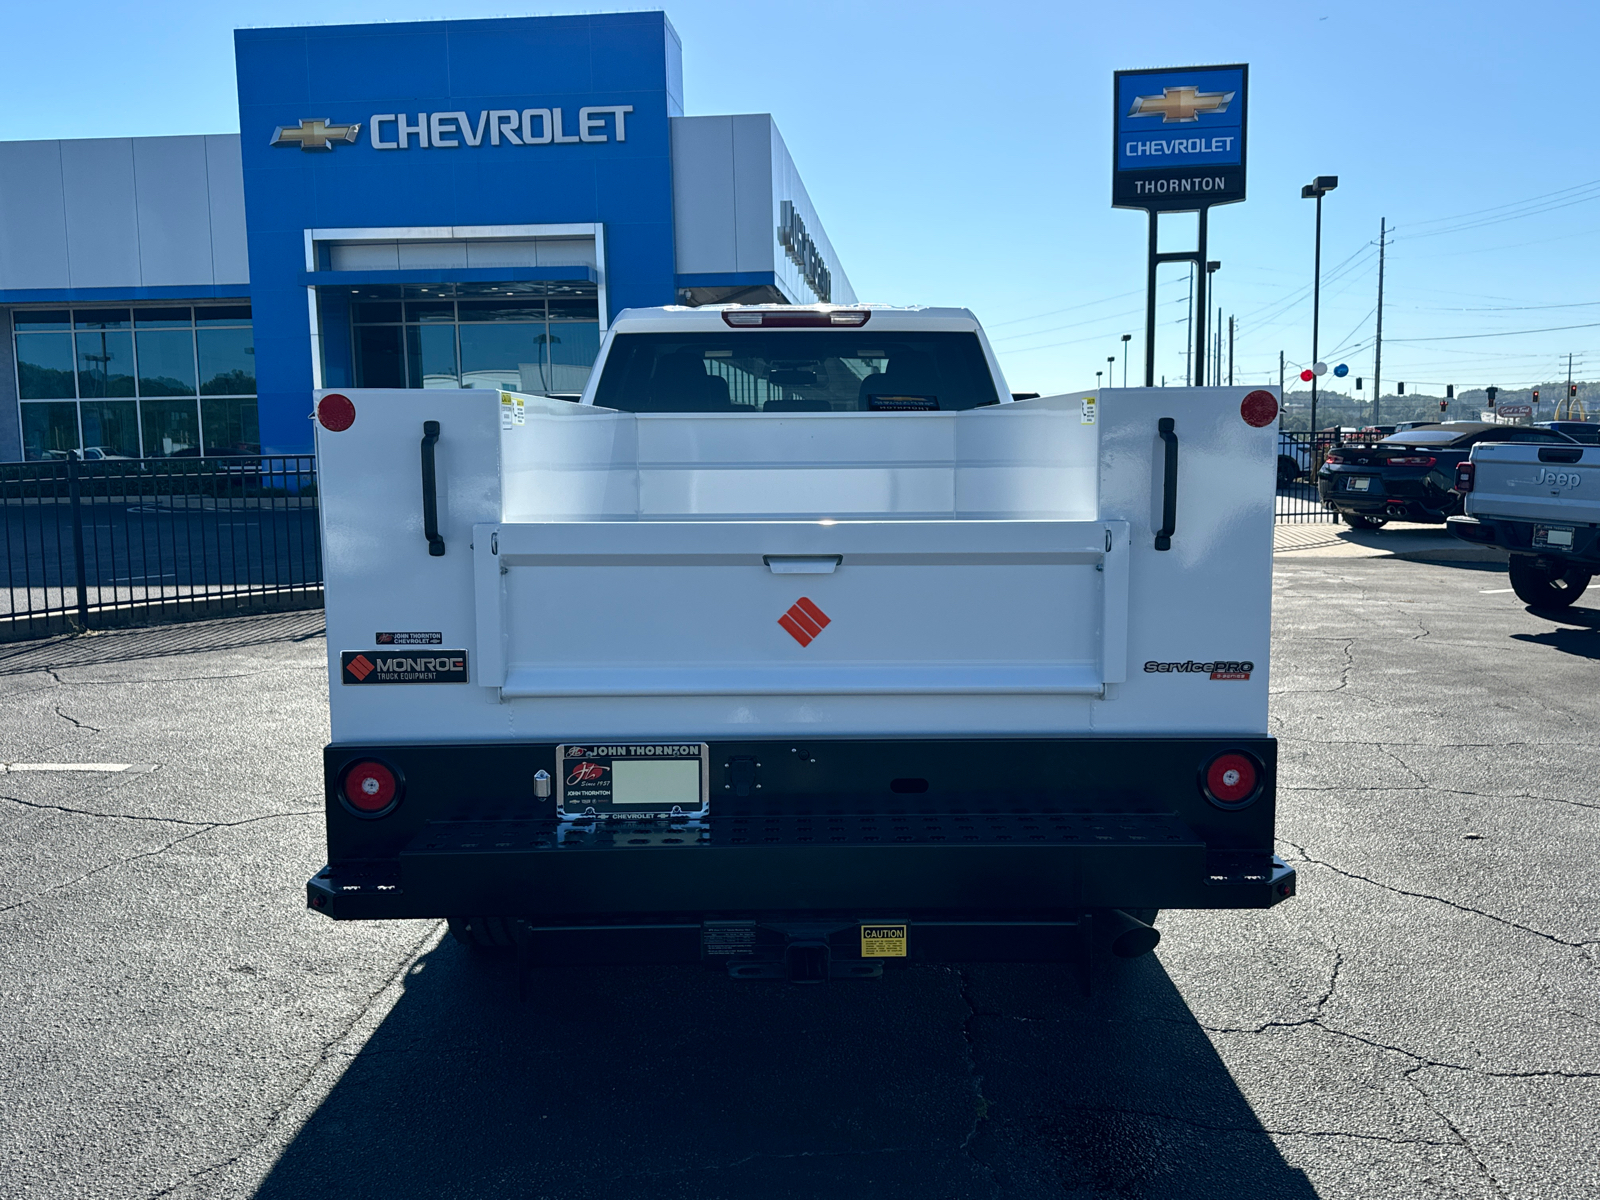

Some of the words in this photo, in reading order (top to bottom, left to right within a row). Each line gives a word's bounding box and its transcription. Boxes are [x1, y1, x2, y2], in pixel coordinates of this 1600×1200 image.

[370, 105, 634, 149] CHEVROLET
[1126, 136, 1235, 157] CHEVROLET
[1135, 177, 1225, 193] THORNTON
[1533, 468, 1581, 490] Jeep
[376, 658, 464, 671] MONROE
[1143, 660, 1254, 673] ServicePRO
[400, 672, 437, 680] EQUIPMENT
[592, 746, 626, 756] JOHN
[629, 745, 699, 756] THORNTON
[865, 930, 902, 938] CAUTION
